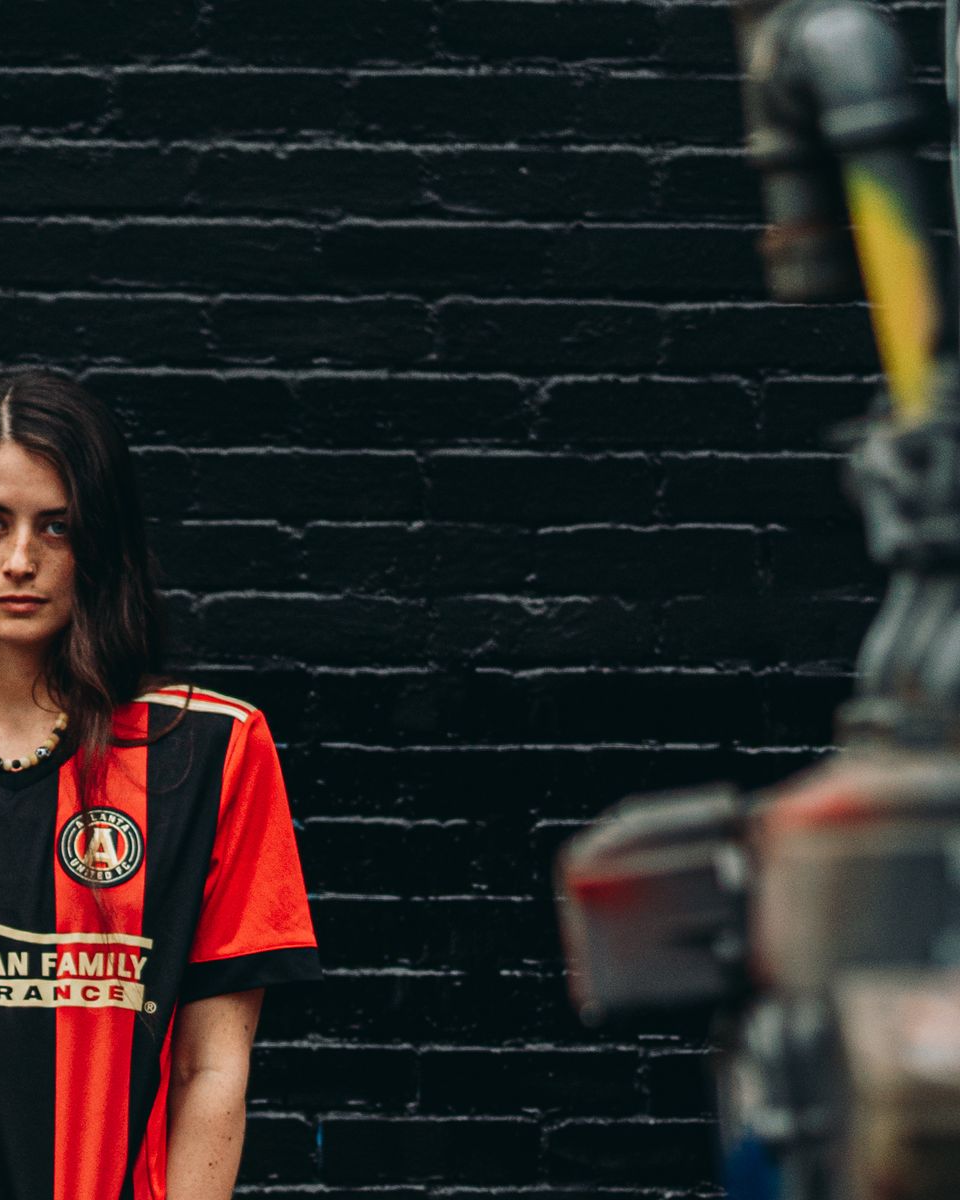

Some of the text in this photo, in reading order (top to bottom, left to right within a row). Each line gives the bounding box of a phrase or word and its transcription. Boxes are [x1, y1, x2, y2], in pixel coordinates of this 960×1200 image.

[75, 813, 130, 832] ALANTA
[115, 861, 131, 875] FC
[41, 951, 148, 980] FAMILY
